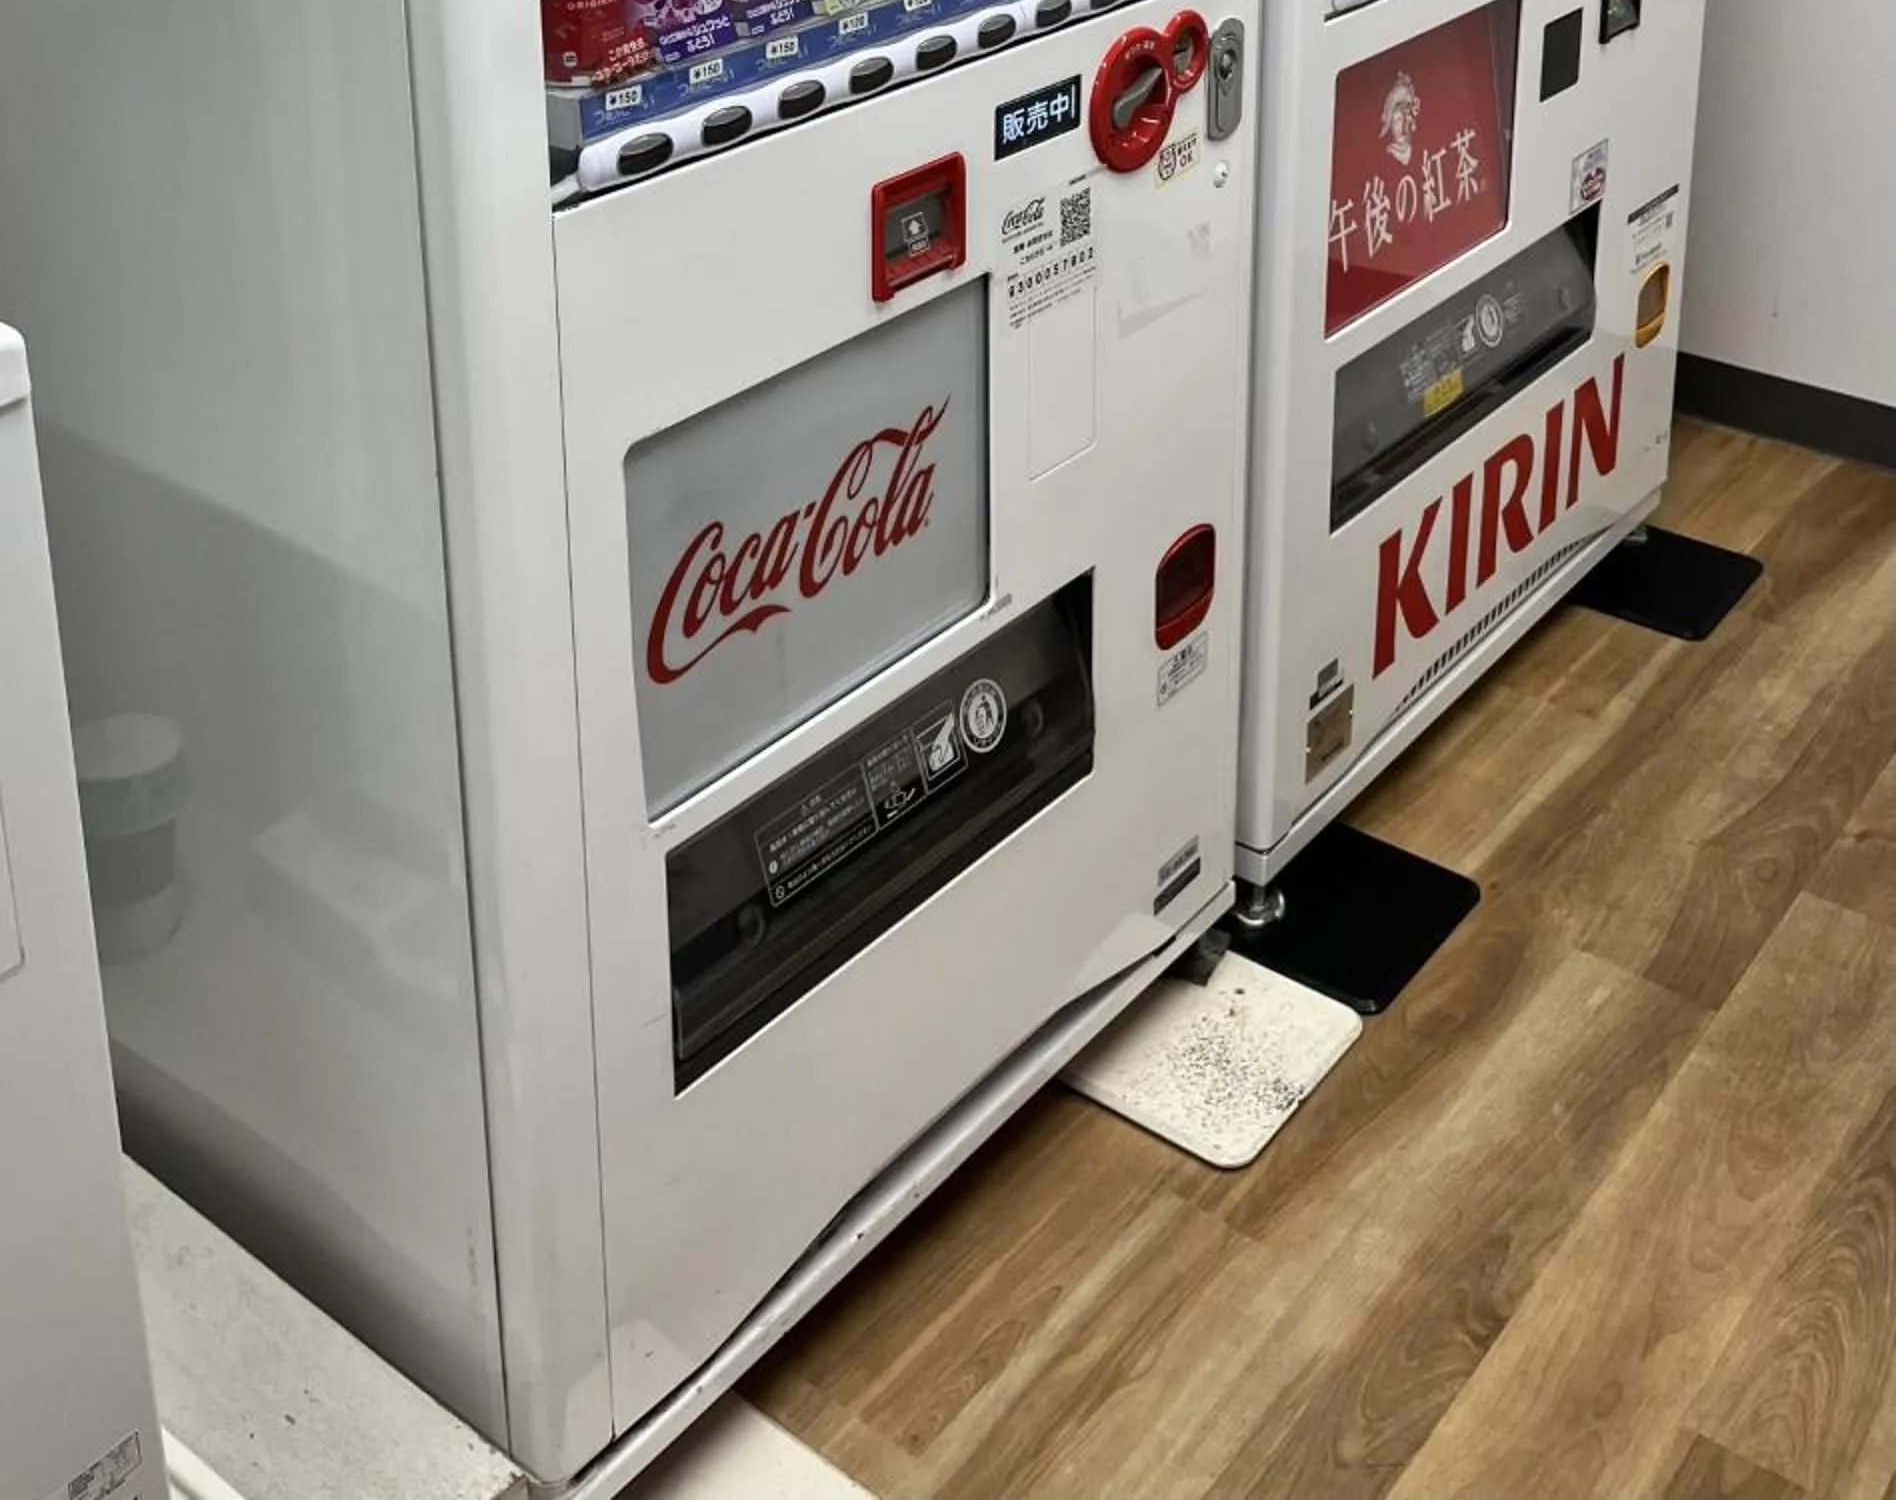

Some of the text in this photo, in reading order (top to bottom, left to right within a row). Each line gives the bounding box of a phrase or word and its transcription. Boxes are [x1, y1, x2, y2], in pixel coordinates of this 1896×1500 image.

[693, 62, 720, 80] ¥150
[609, 89, 639, 106] ¥150
[1001, 92, 1072, 144] 販売中
[1179, 151, 1194, 169] OK
[1328, 128, 1482, 273] 午後の紅茶
[646, 394, 952, 686] Coca-Cola
[1371, 352, 1625, 680] KIRIN
